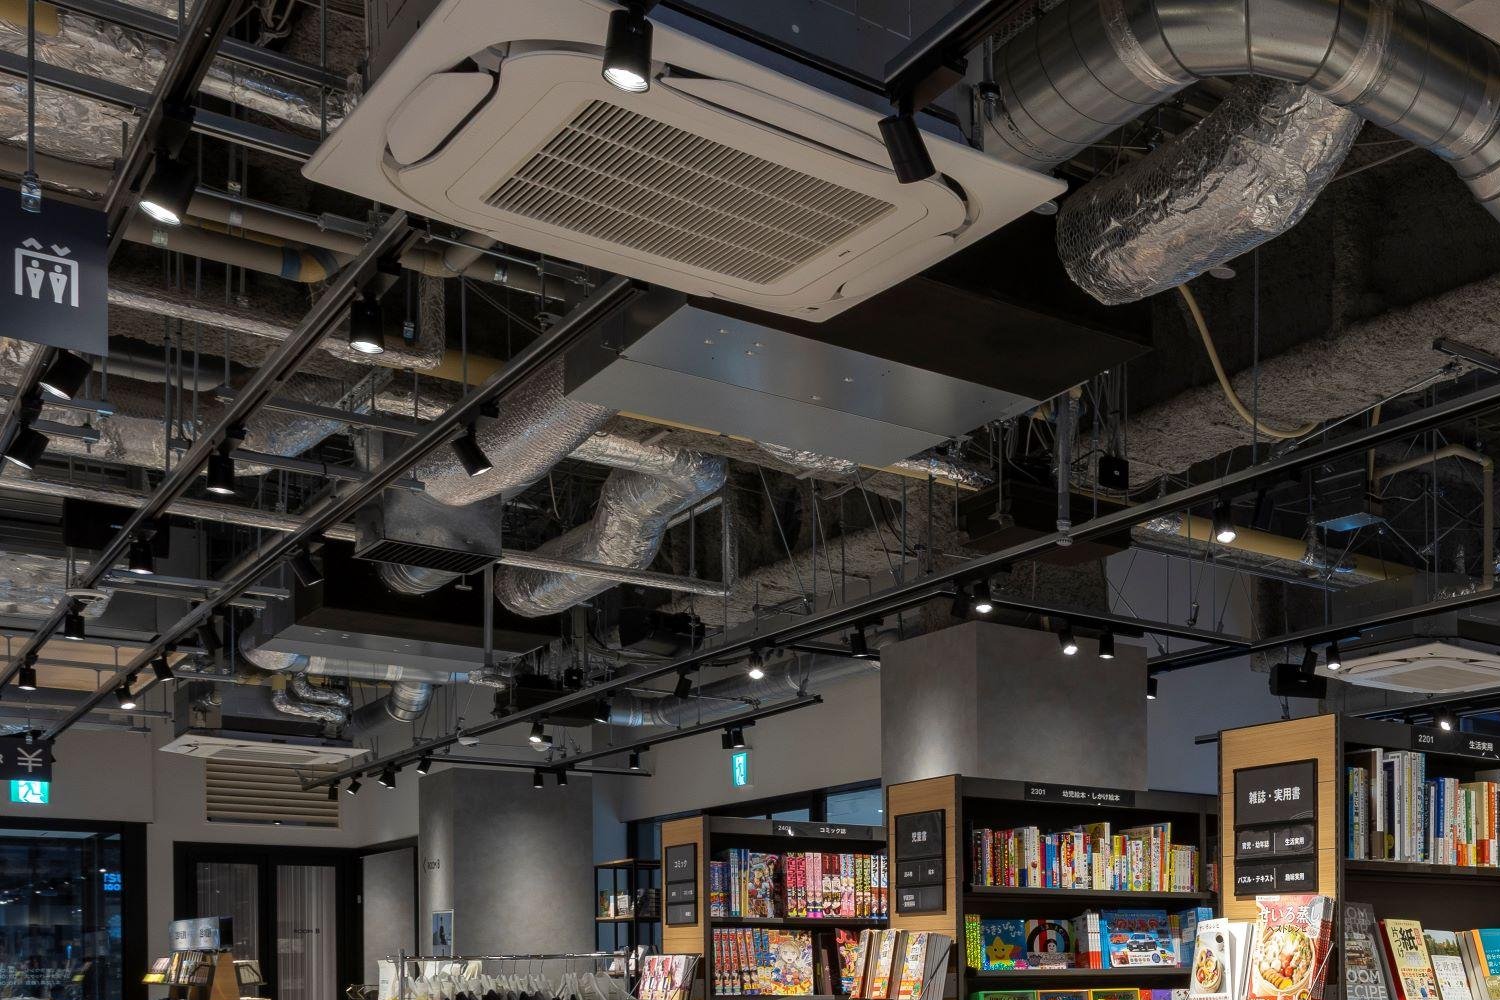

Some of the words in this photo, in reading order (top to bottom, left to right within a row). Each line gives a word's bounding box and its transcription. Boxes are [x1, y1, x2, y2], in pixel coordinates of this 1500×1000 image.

[1418, 734, 1434, 744] 2201
[1248, 786, 1301, 804] 雑誌・実用書
